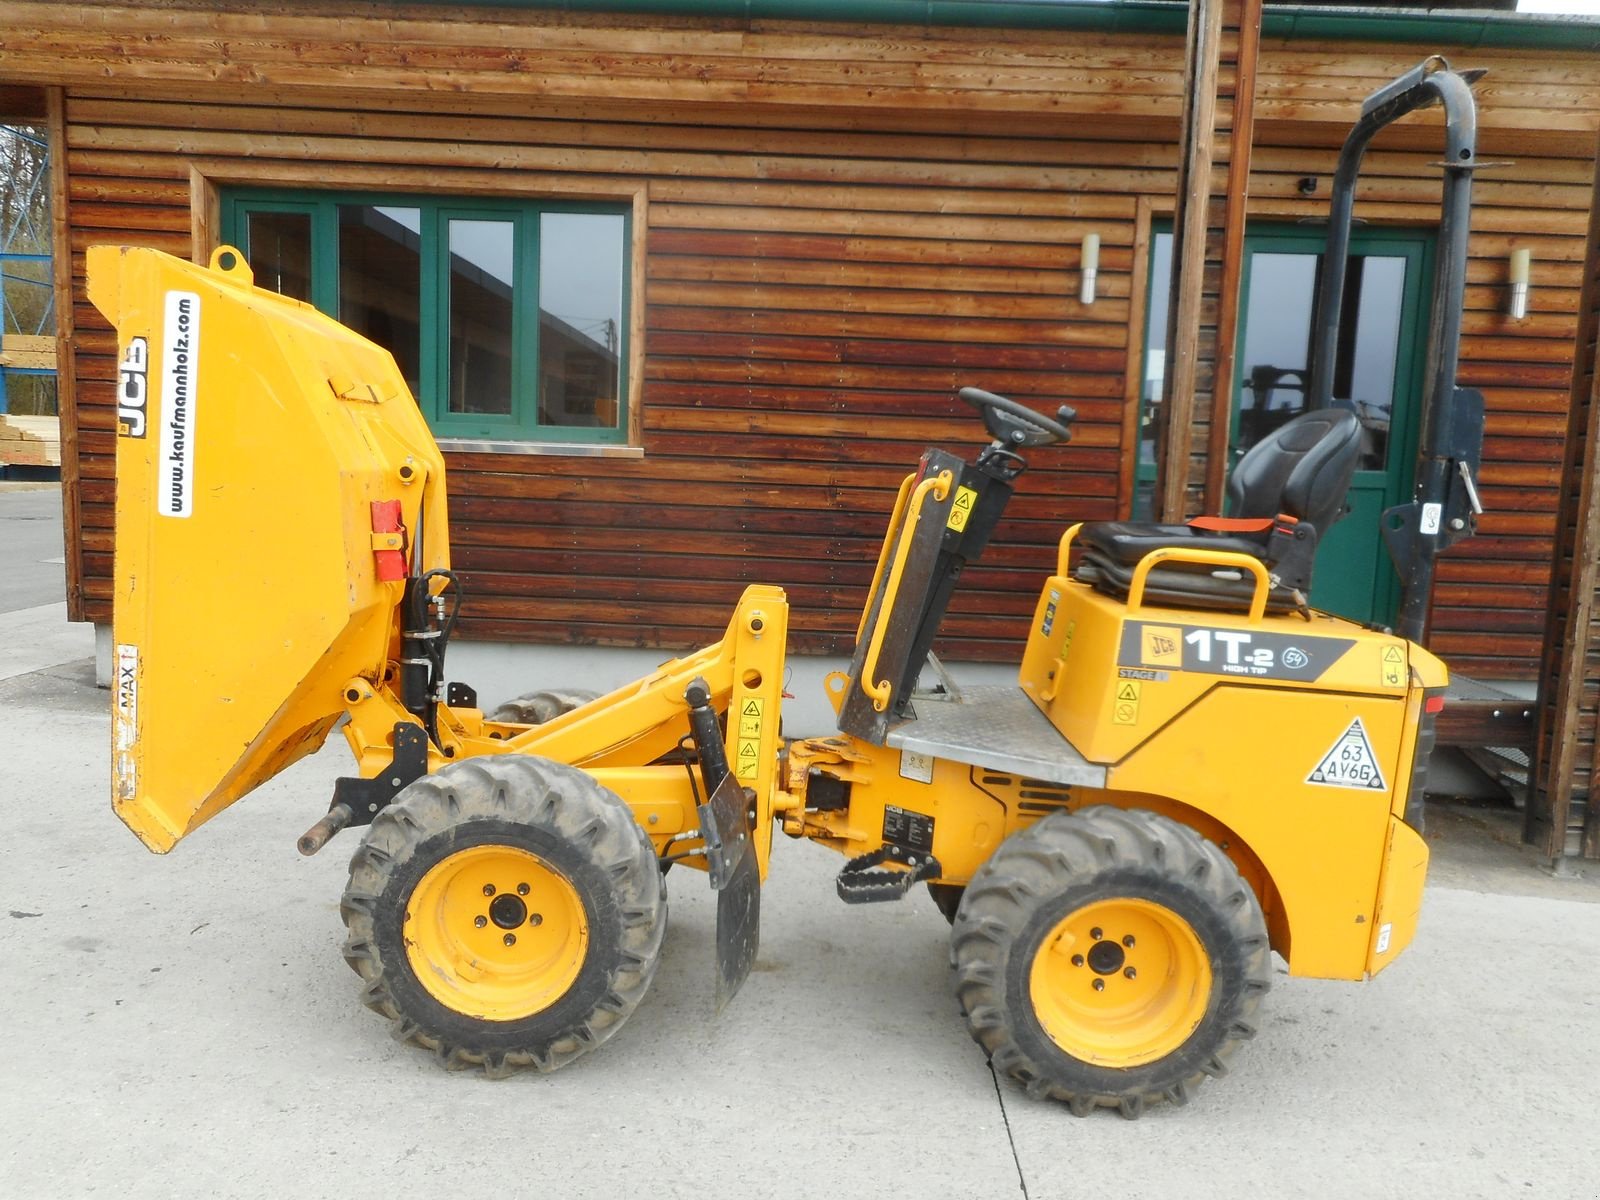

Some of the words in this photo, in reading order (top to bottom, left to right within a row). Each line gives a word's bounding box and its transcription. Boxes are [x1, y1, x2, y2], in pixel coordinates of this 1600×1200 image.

[118, 337, 147, 437] JCB
[169, 298, 191, 513] www.kaufmannholz.com
[1152, 636, 1175, 654] JCB
[1286, 651, 1302, 666] 54
[1119, 669, 1156, 680] STAGE
[1222, 664, 1249, 674] HIGH
[1251, 666, 1268, 675] TIP
[121, 666, 134, 708] MAX
[1341, 744, 1363, 762] 63
[1327, 761, 1371, 780] AY6G
